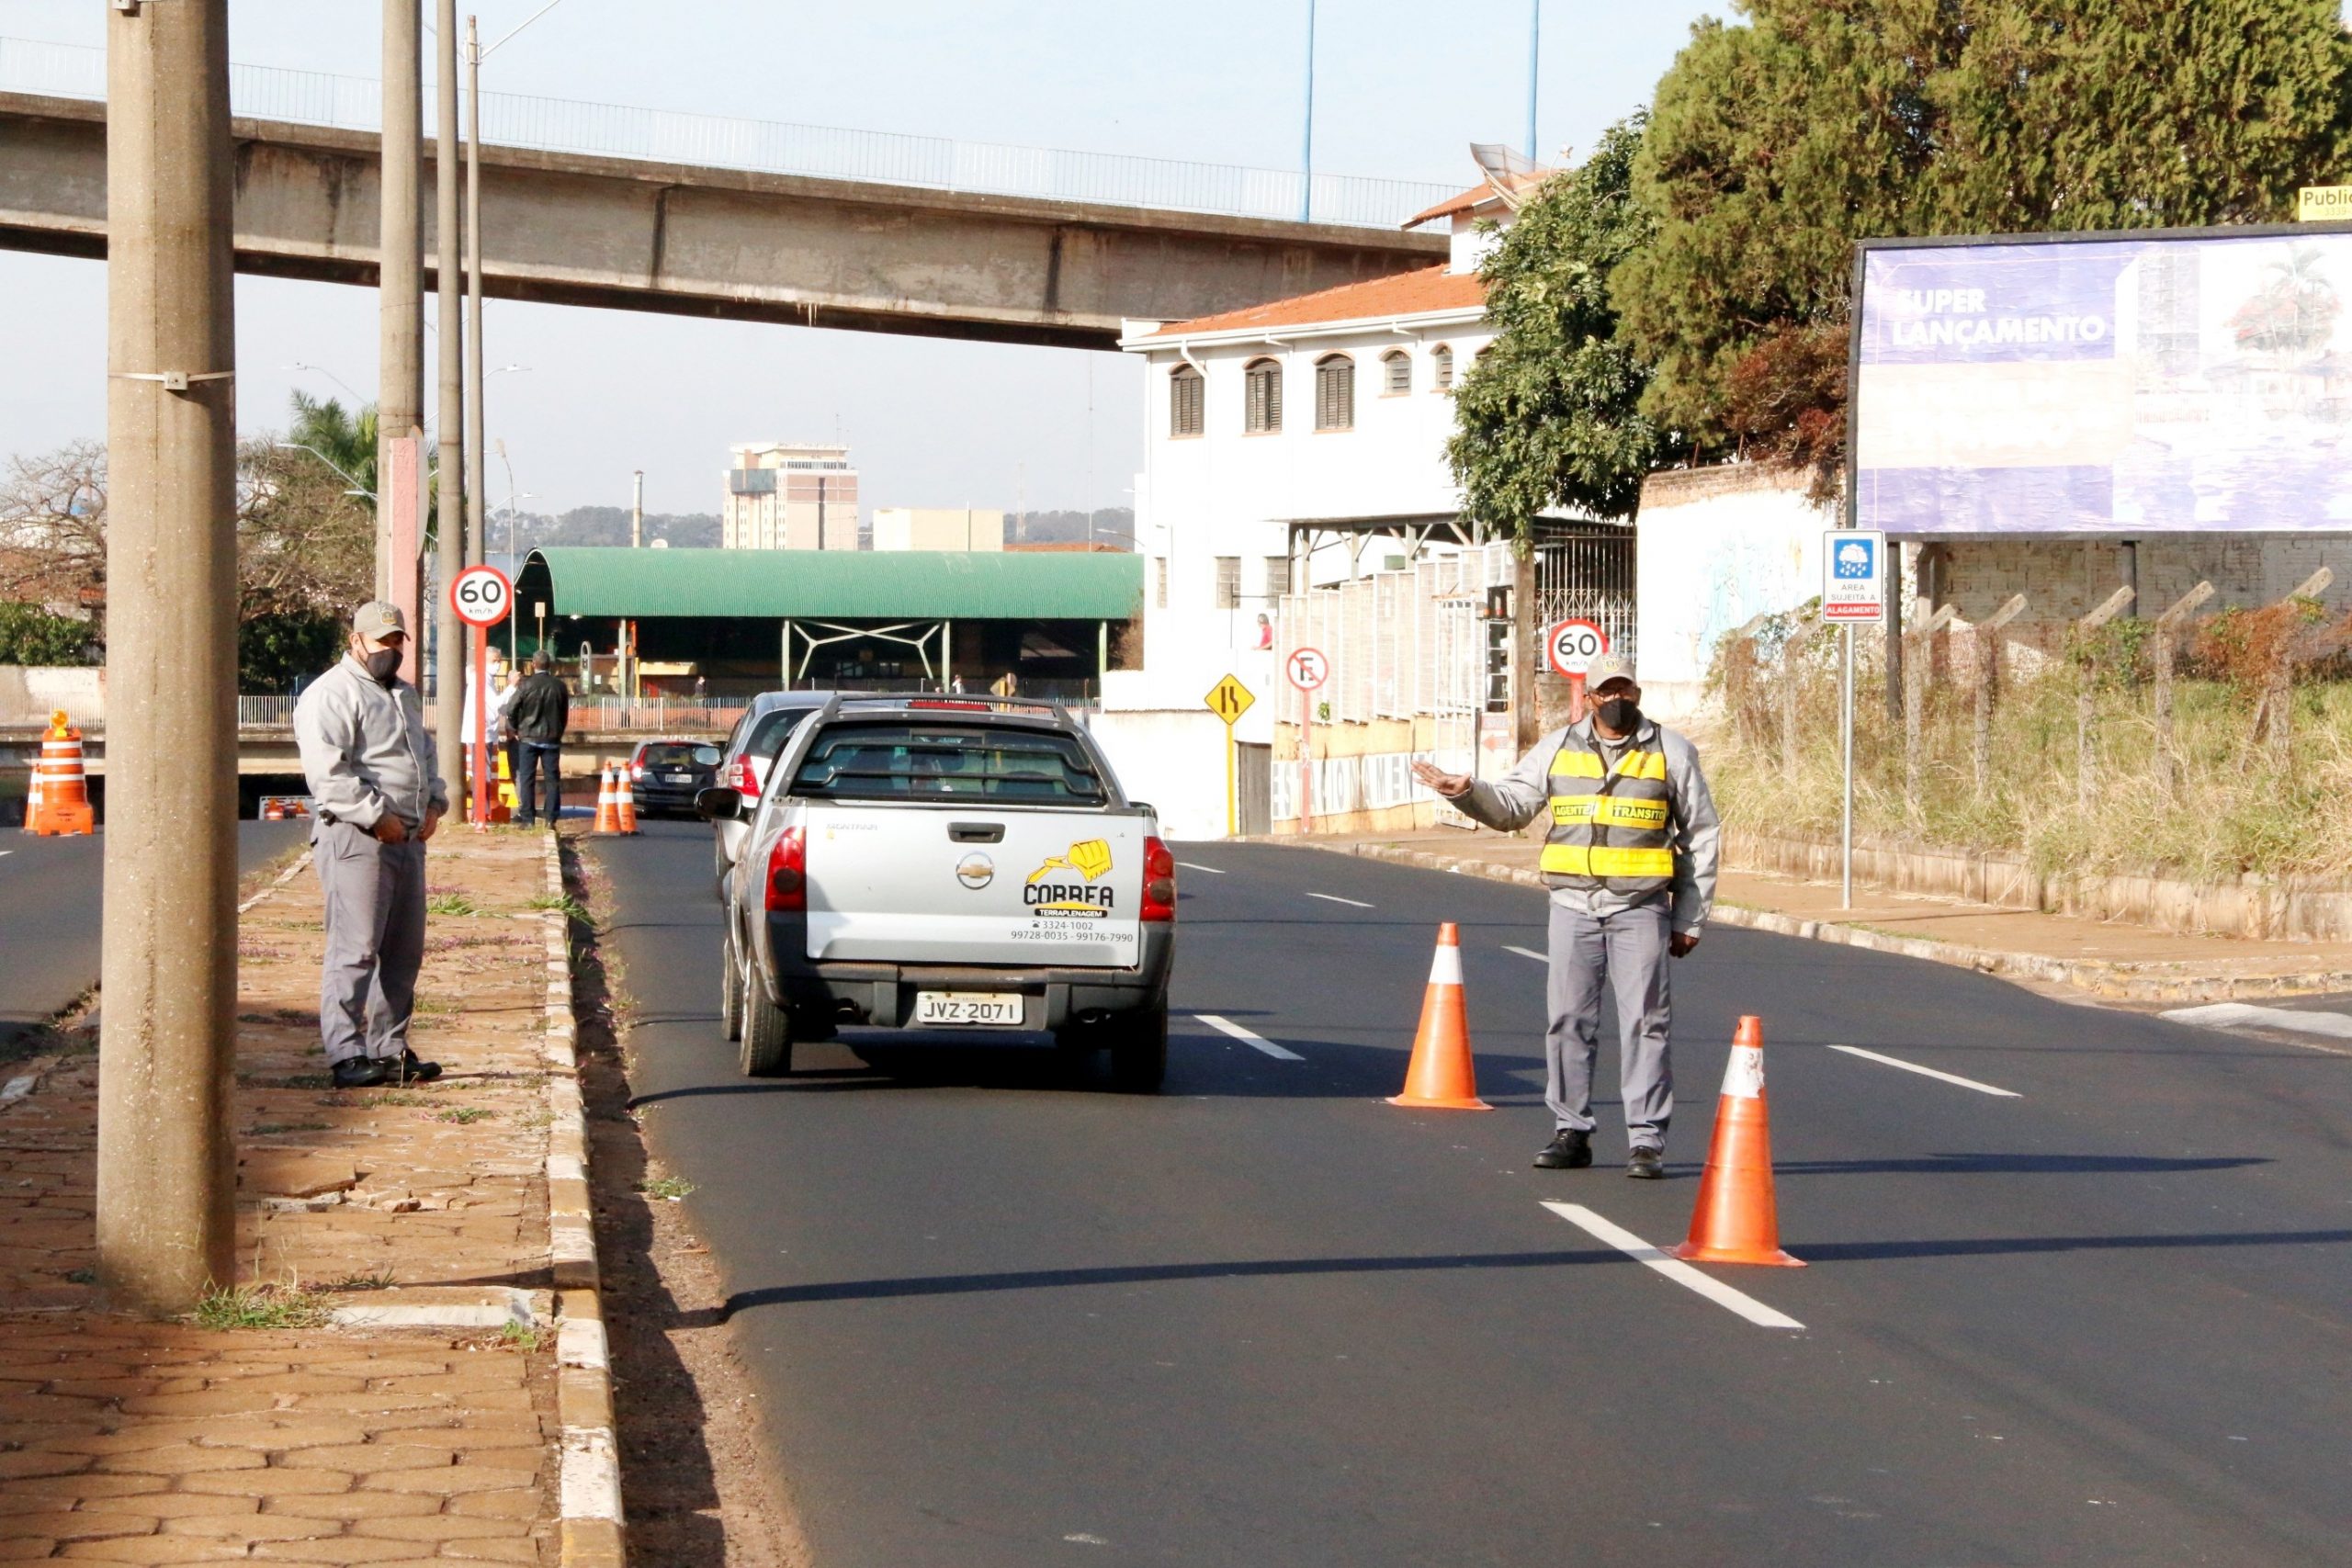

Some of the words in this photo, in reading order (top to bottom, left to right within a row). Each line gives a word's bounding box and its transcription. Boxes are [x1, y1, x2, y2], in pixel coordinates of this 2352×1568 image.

[1896, 288, 1986, 314] SUPER
[1892, 315, 2106, 352] LANÇAMENTO
[460, 580, 502, 604] 60
[1831, 593, 1865, 602] SUJEITA
[1870, 593, 1876, 602] A
[1826, 606, 1880, 615] ALAGAMENTO
[1557, 633, 1597, 656] 60
[1555, 805, 1590, 816] AGENTE
[1039, 908, 1102, 918] TERRAPLENAGEM
[1043, 920, 1093, 931] 3324-1002
[1011, 931, 1069, 941] 99728-0035
[1076, 932, 1134, 942] 99176-7990
